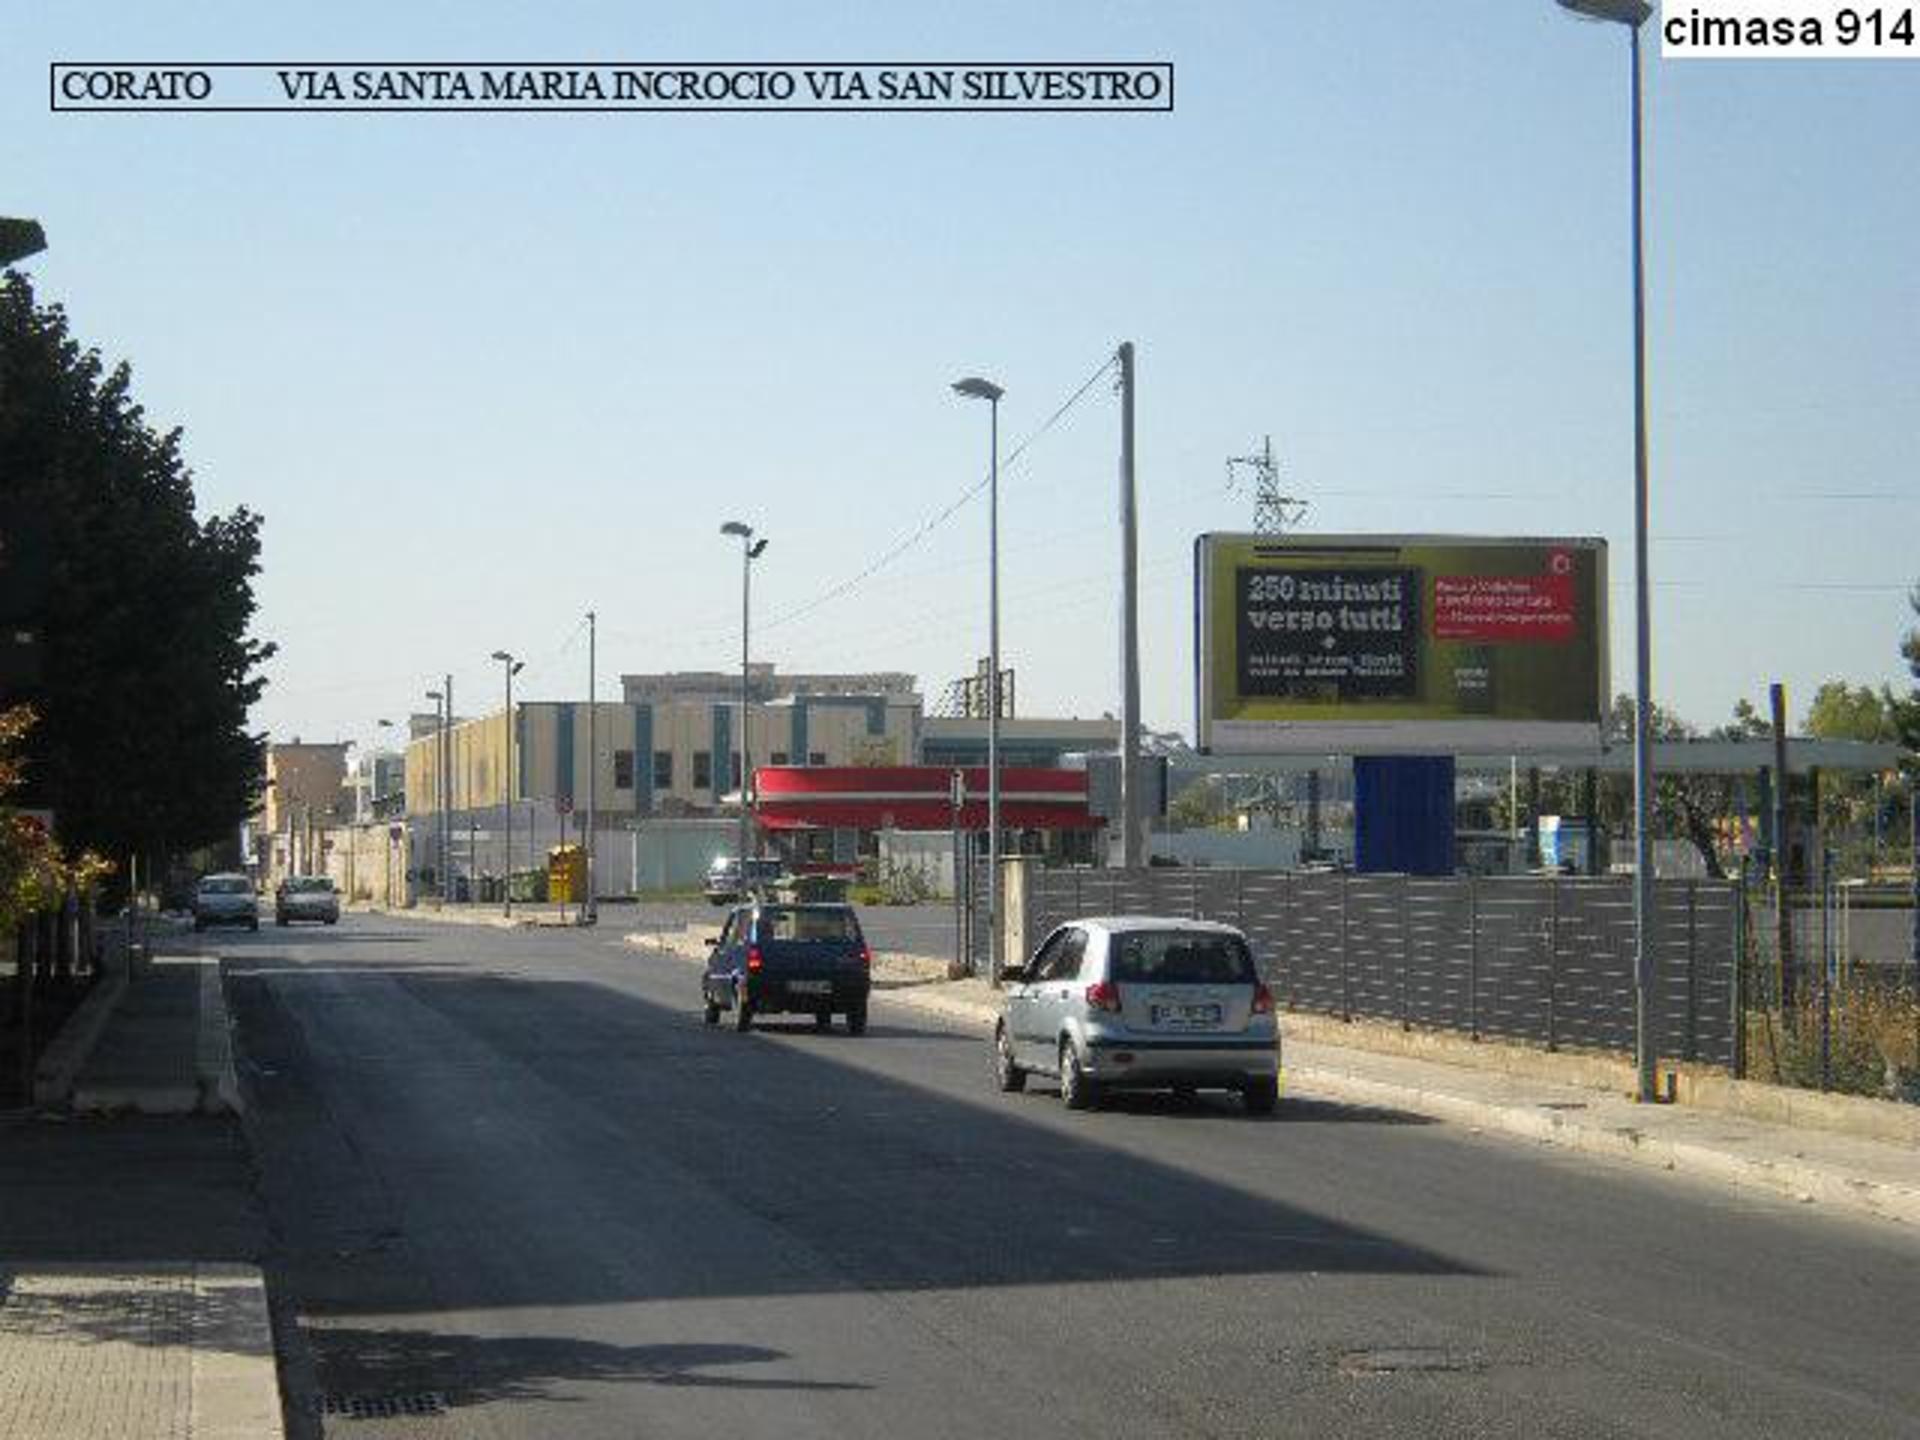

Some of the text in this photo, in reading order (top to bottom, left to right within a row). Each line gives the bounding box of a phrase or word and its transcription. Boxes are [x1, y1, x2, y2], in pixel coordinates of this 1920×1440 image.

[1247, 575, 1295, 601] 250
[1247, 605, 1402, 631] verso tutti
